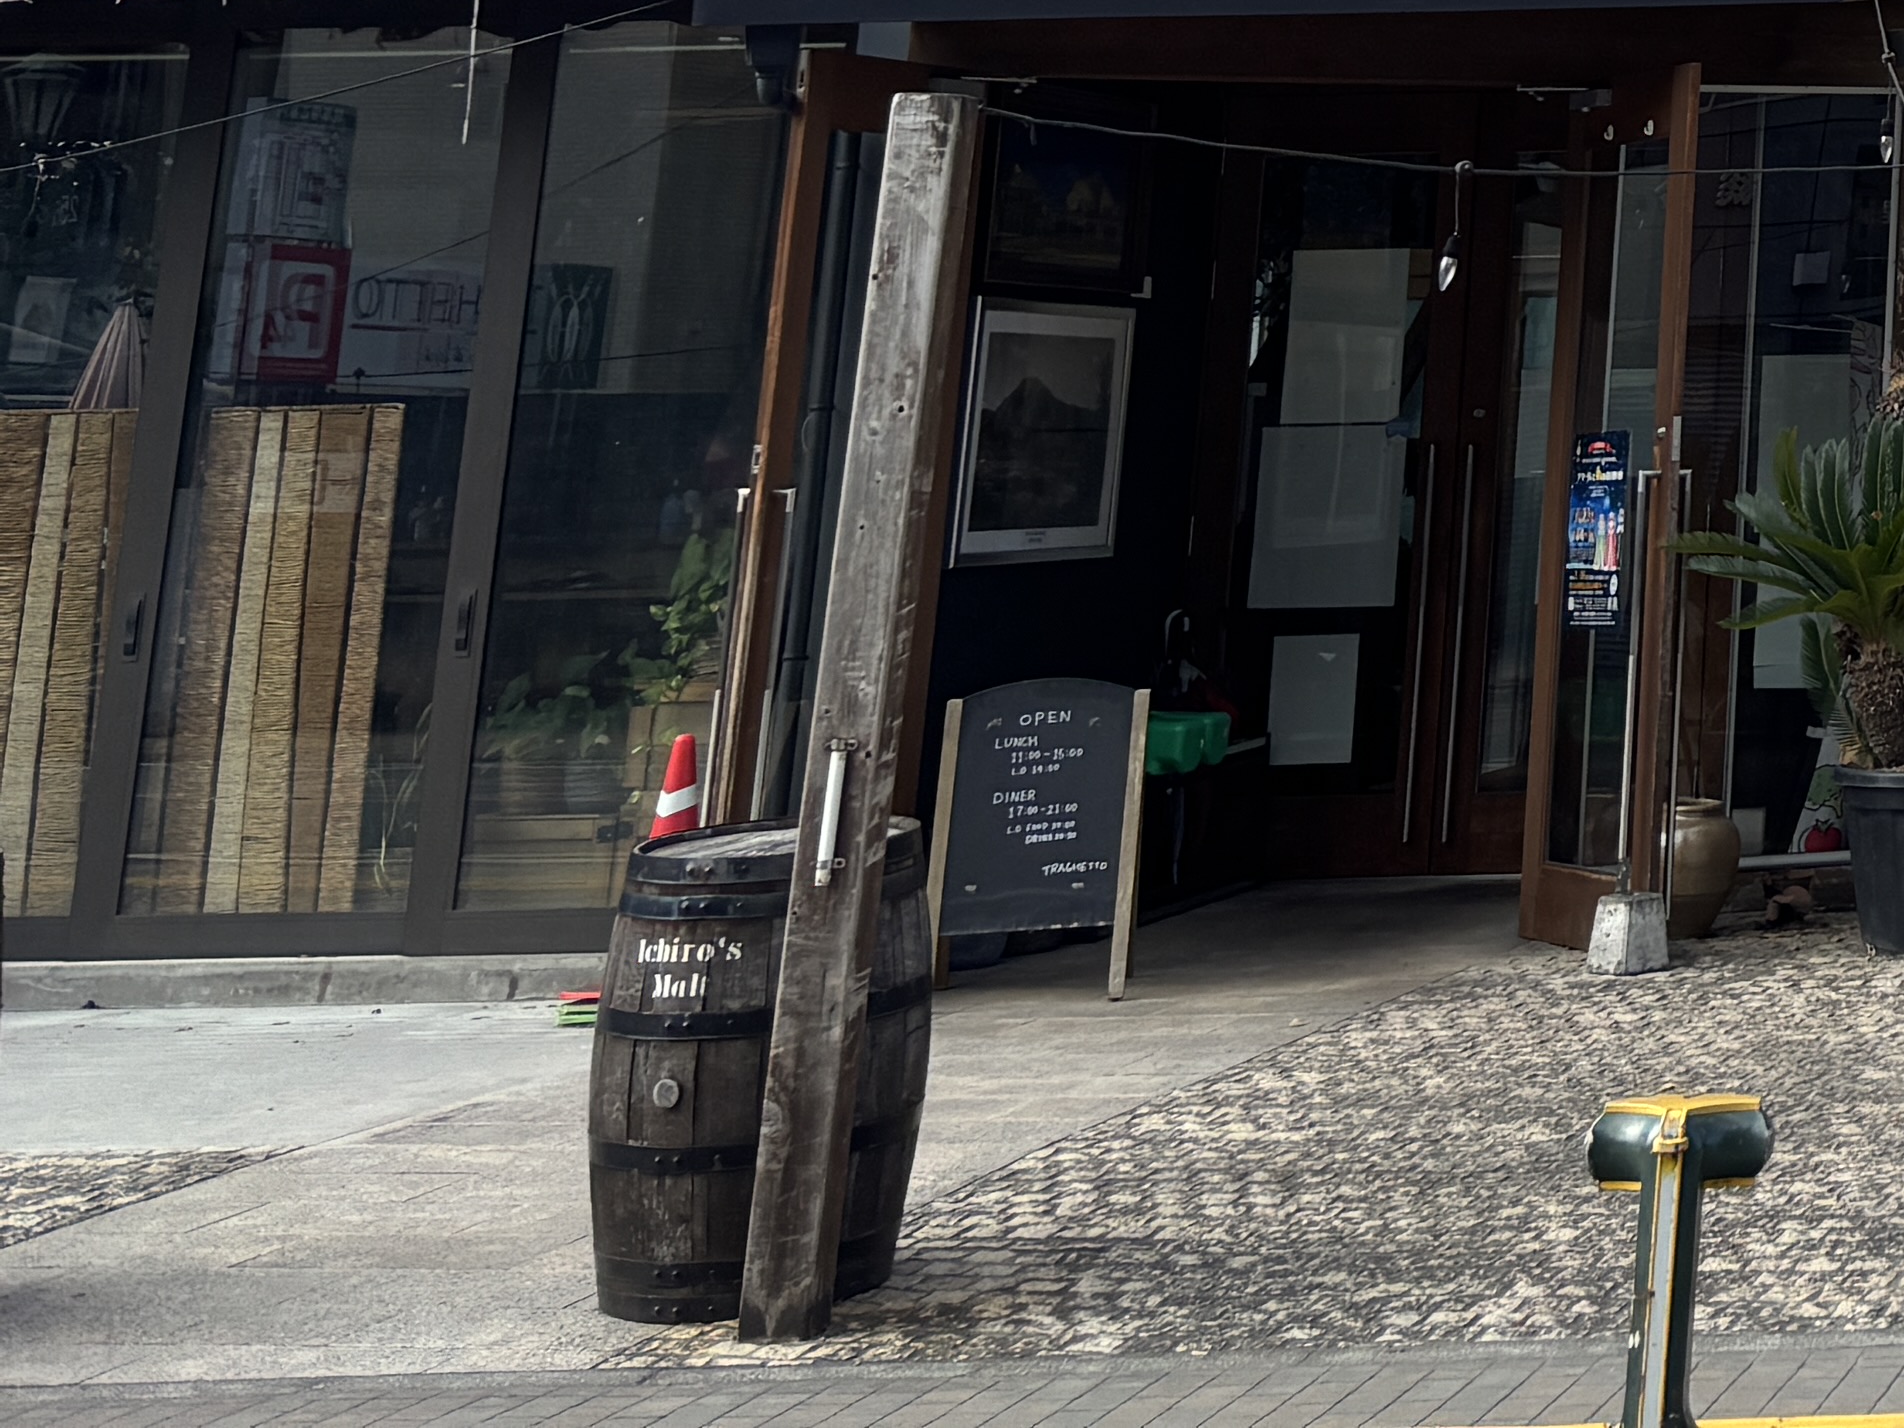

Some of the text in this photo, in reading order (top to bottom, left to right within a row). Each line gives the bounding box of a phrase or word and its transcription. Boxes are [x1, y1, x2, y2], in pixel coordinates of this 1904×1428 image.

[1020, 710, 1072, 726] OPEN
[995, 736, 1038, 749] LUNCH
[993, 789, 1036, 804] DINER
